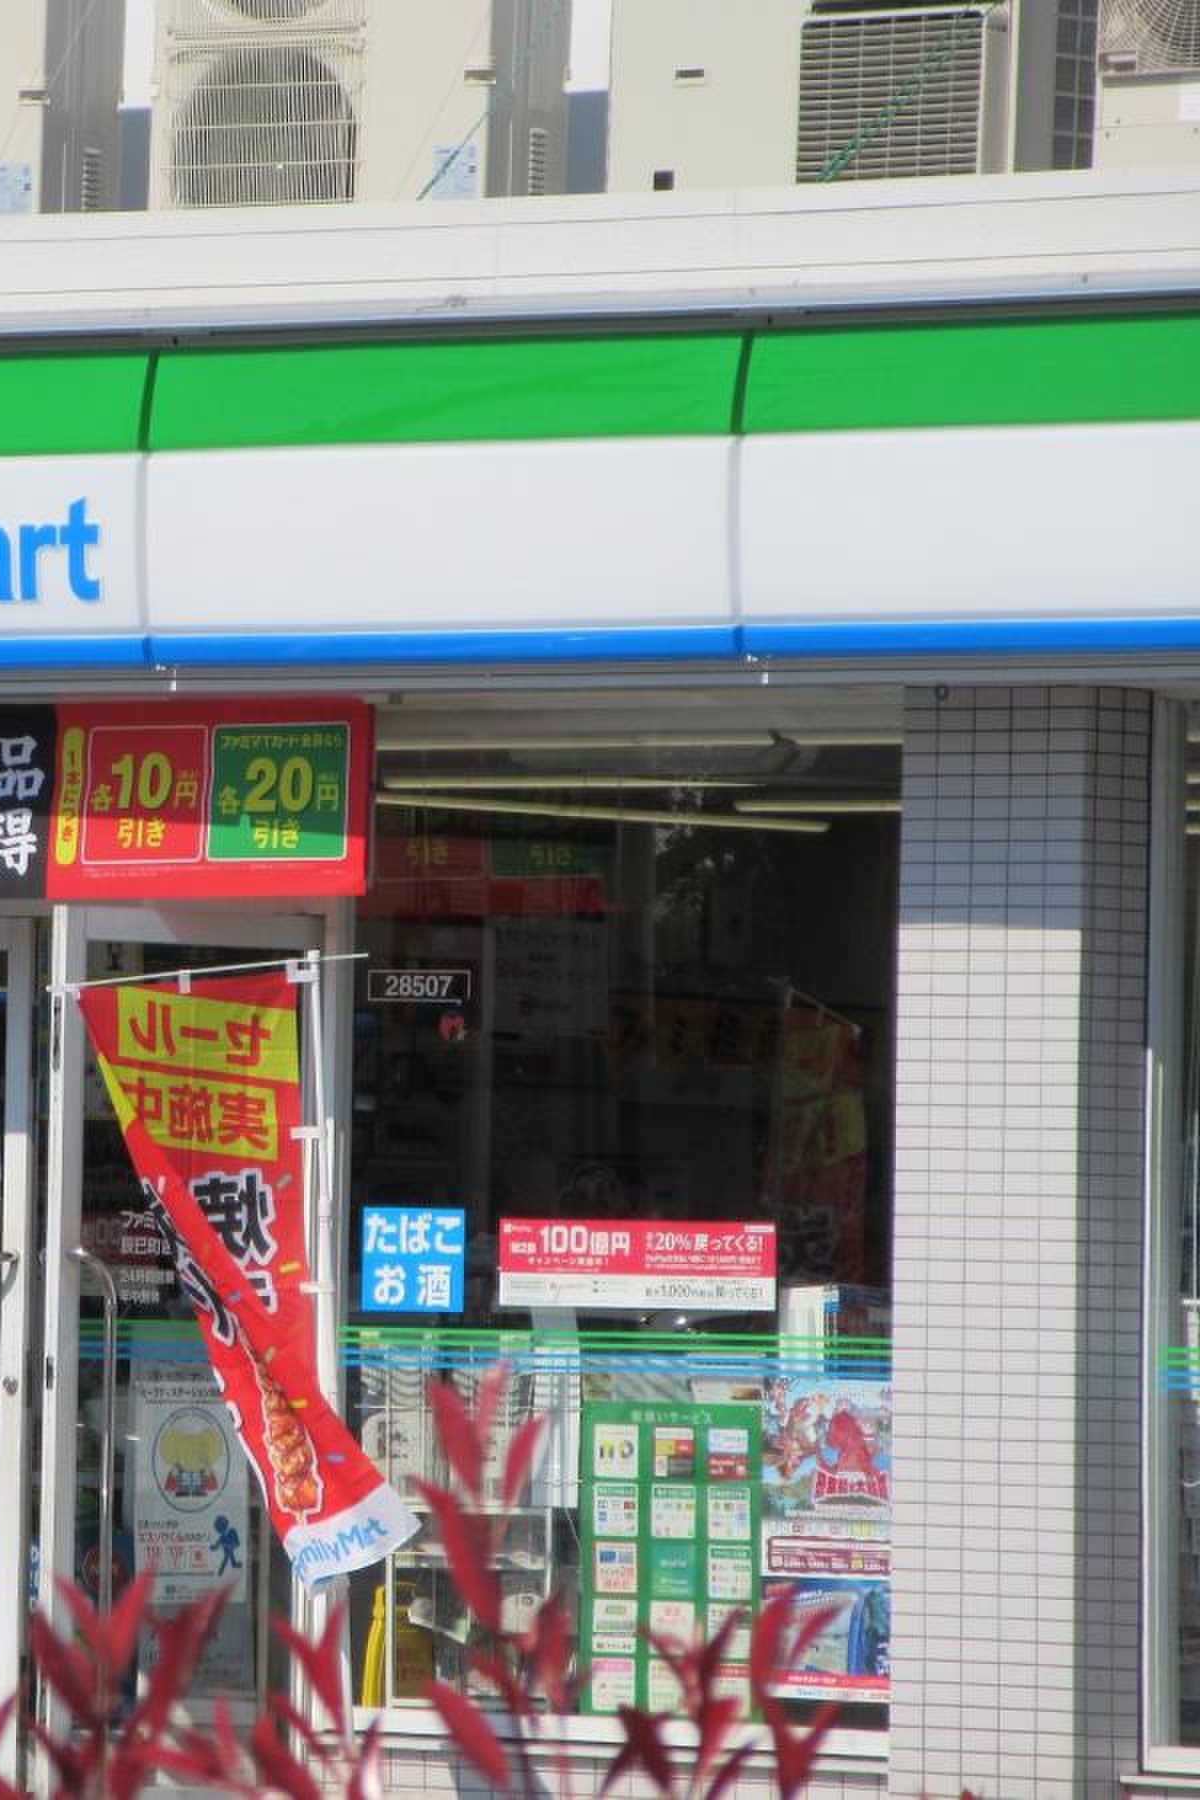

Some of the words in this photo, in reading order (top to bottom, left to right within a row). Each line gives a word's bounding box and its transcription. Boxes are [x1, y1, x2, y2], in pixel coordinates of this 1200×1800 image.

[118, 818, 167, 848] 引き
[253, 823, 301, 850] 引き
[384, 975, 454, 997] 28507
[365, 1213, 463, 1254] たばこ
[374, 1264, 451, 1308] お酒
